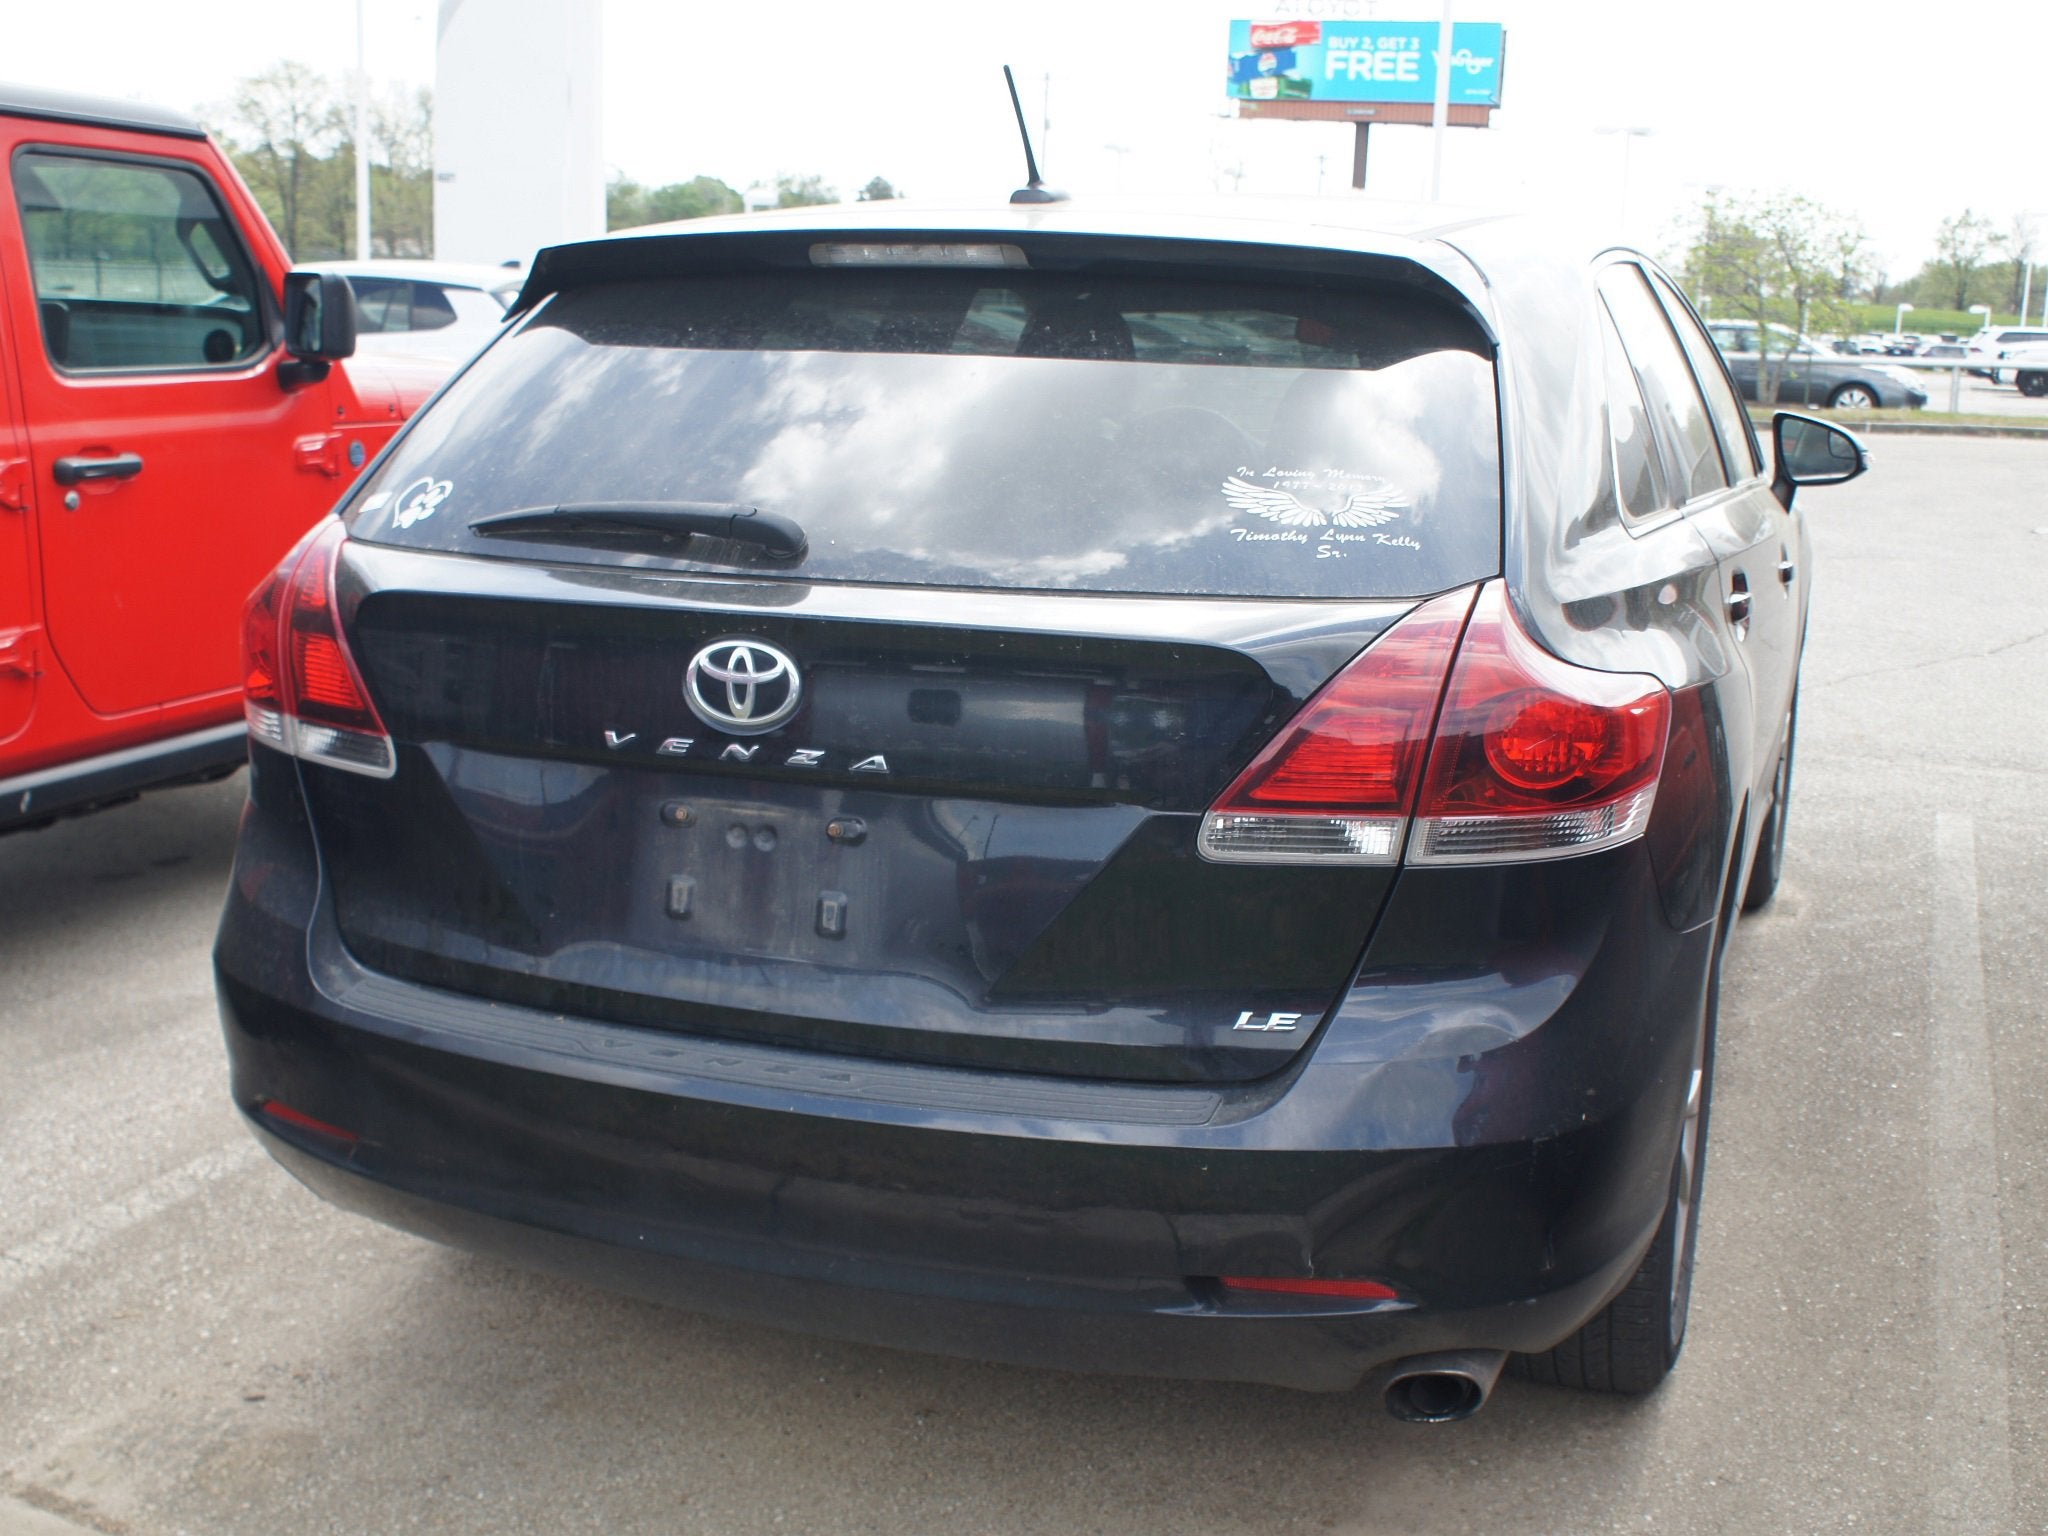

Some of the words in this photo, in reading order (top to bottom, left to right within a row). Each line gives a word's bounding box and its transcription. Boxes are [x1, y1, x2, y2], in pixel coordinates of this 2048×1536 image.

[1328, 36, 1358, 49] BUY
[1377, 36, 1407, 49] GET
[1410, 37, 1420, 50] 3
[1325, 50, 1421, 81] FREE
[1236, 466, 1254, 478] In
[1262, 466, 1315, 480] Loving
[1323, 468, 1386, 483] Memory
[1230, 529, 1308, 544] Timothy
[1320, 529, 1366, 544] Lynn
[1372, 533, 1421, 550] Kelly
[1316, 545, 1347, 559] Sr.
[604, 730, 890, 773] VENZA
[1233, 1011, 1301, 1031] LE
